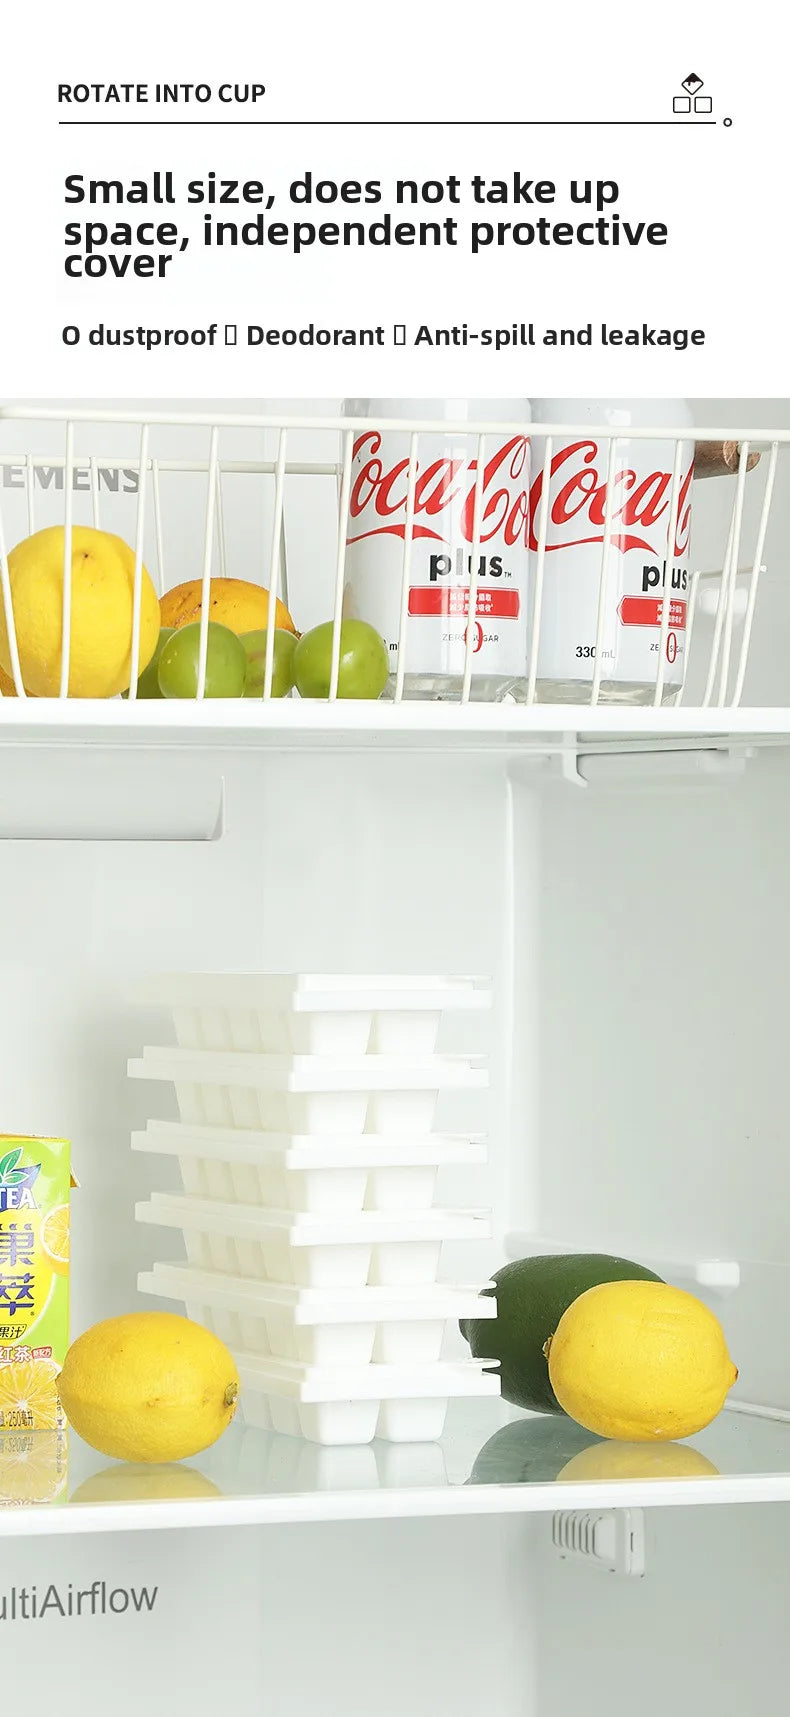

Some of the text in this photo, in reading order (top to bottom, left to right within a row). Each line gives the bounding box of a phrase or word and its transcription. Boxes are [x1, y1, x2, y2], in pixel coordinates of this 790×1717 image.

[429, 547, 503, 581] plus
[641, 560, 688, 592] plus
[575, 646, 616, 659] 330 mL
